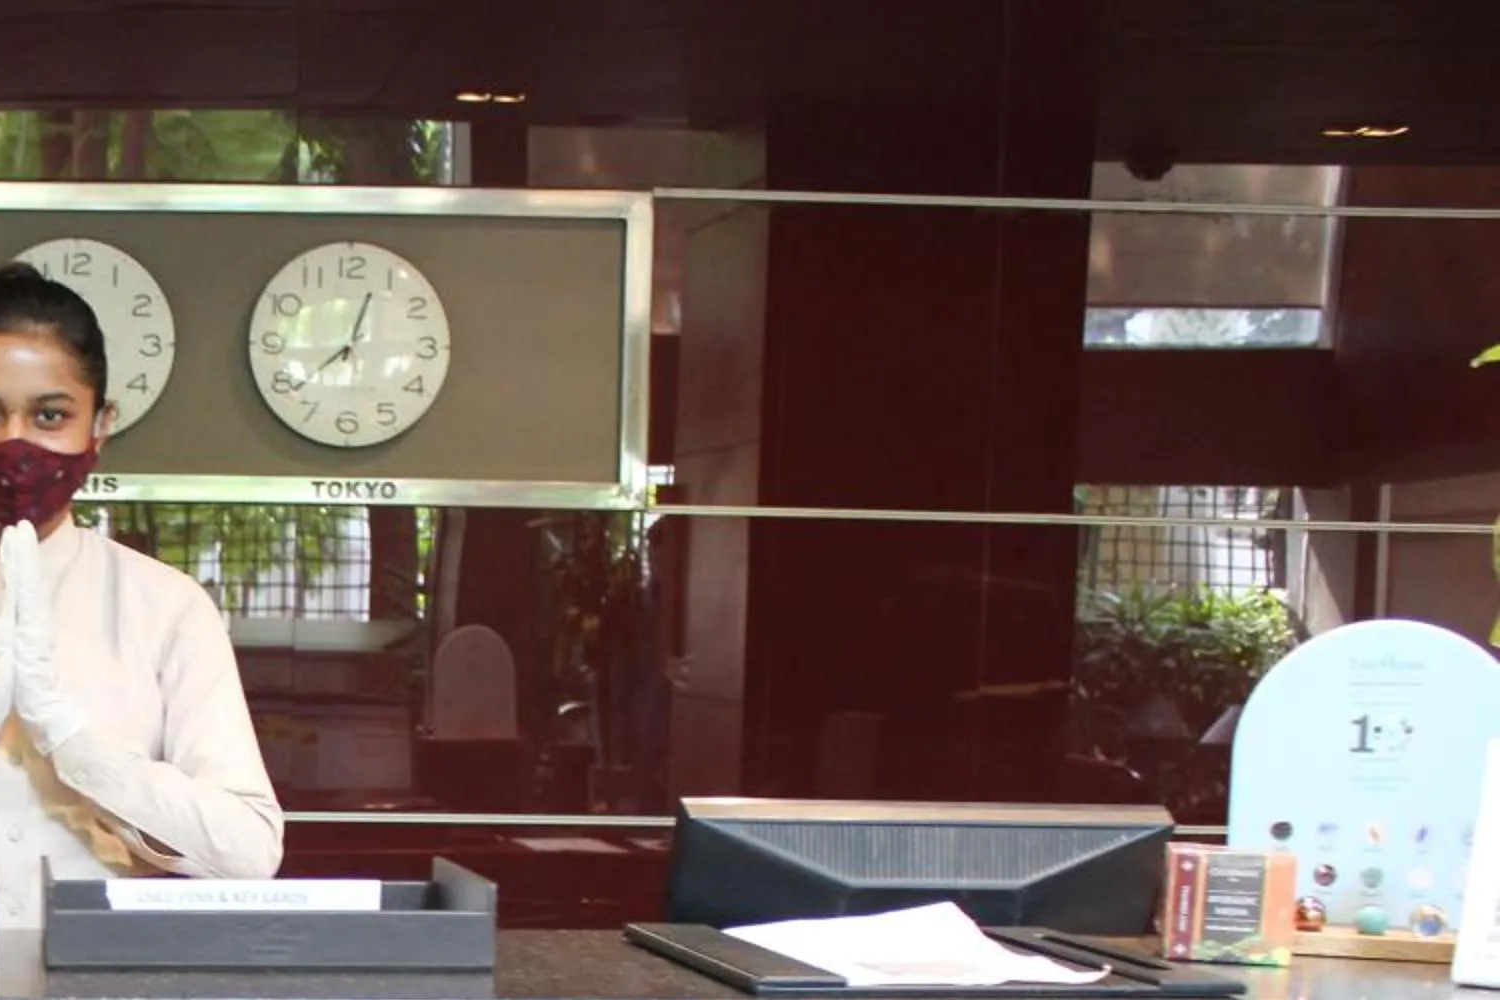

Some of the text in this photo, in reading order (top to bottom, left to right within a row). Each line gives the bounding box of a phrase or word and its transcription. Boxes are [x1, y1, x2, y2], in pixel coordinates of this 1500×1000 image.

[63, 253, 93, 276] 12
[338, 257, 368, 279] 12
[301, 265, 324, 287] 11
[131, 295, 153, 317] 2
[271, 295, 302, 317] 10
[406, 297, 428, 319] 2
[139, 334, 162, 356] 3
[261, 332, 285, 354] 9
[415, 337, 439, 359] 3
[126, 373, 149, 393] 4
[271, 372, 294, 393] 8
[403, 375, 425, 395] 4
[301, 400, 320, 423] 7
[334, 411, 358, 433] 6
[375, 404, 398, 426] 5
[311, 480, 397, 500] TOKYO
